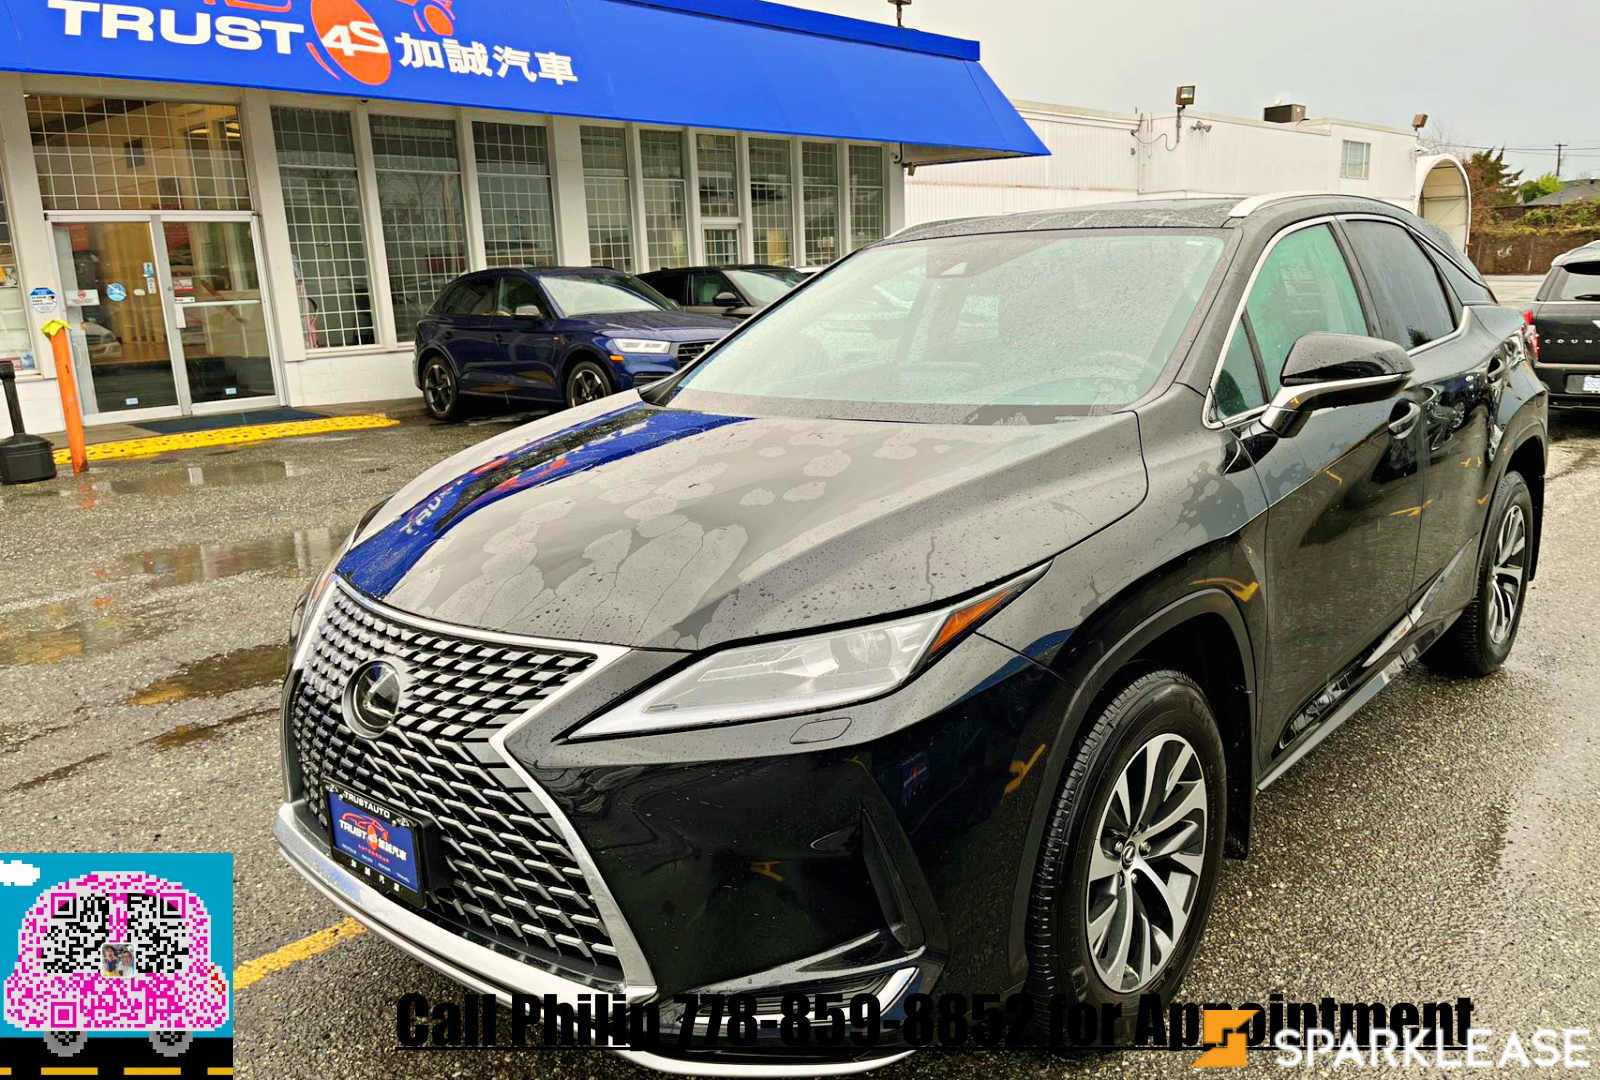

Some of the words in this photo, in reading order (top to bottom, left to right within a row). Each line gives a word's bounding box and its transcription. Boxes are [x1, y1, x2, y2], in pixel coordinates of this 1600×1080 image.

[47, 0, 304, 54] TRUST
[321, 20, 388, 56] 4S
[394, 32, 579, 86] 加誠汽車
[1544, 337, 1600, 345] COUN
